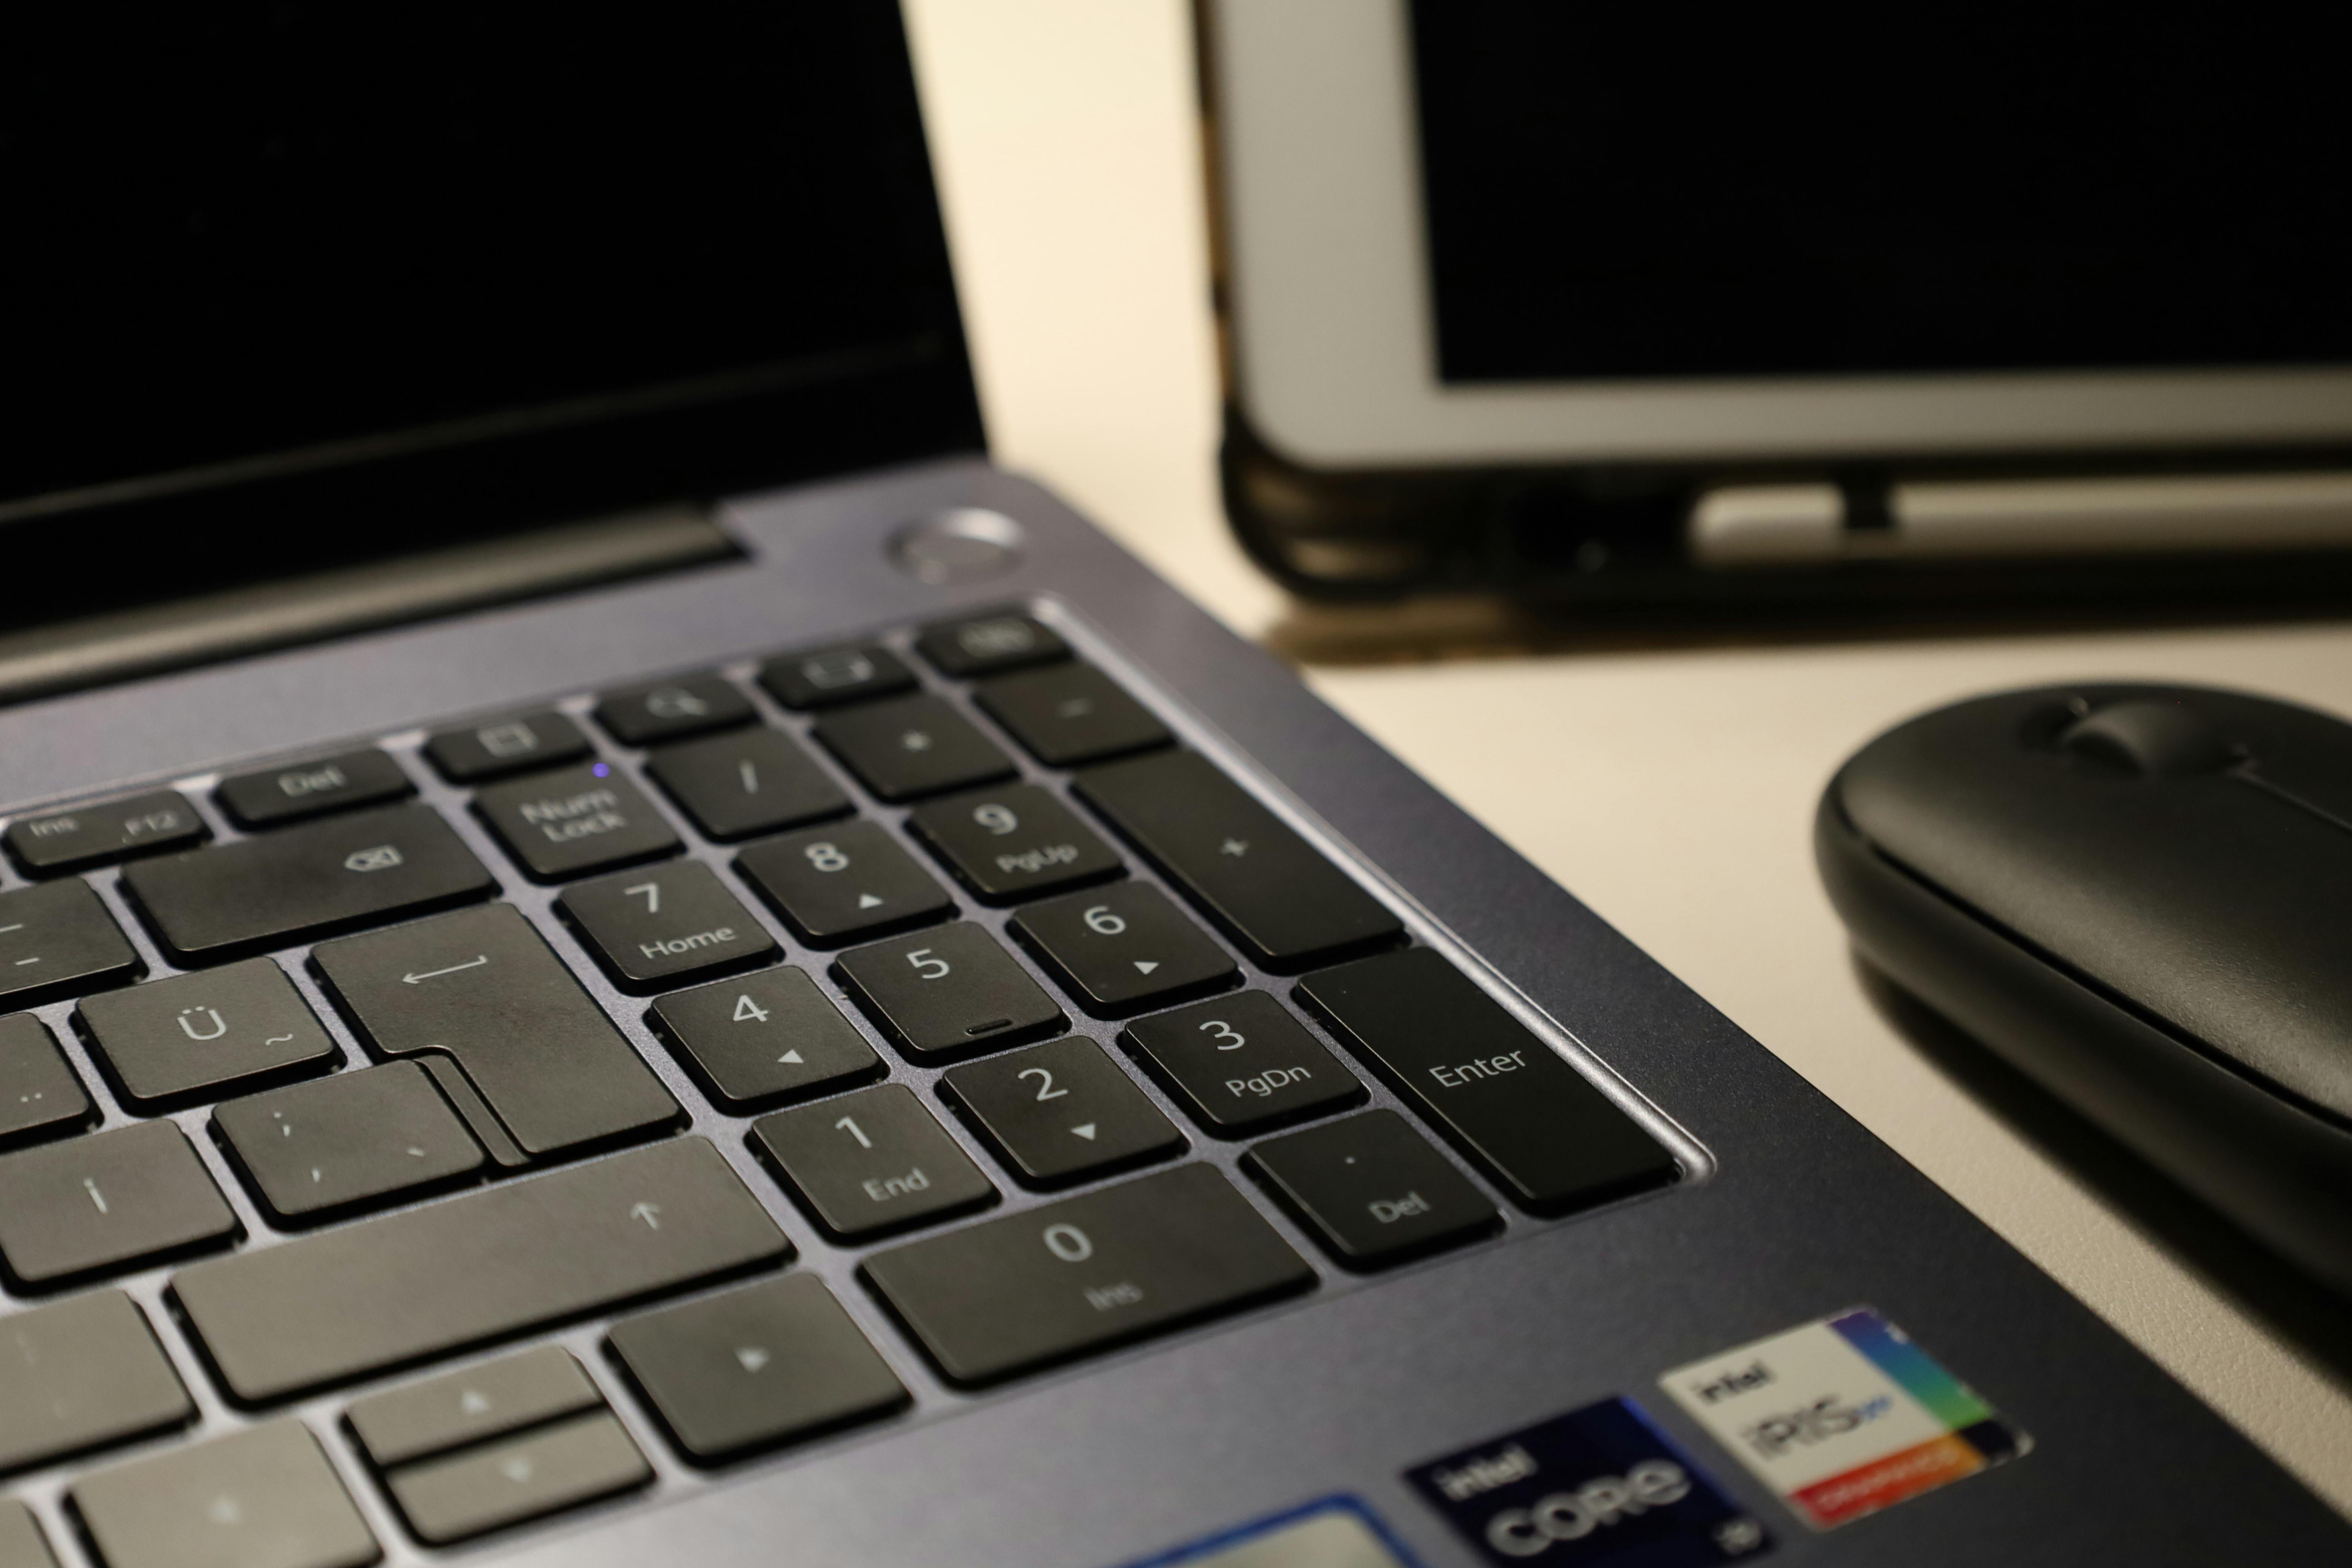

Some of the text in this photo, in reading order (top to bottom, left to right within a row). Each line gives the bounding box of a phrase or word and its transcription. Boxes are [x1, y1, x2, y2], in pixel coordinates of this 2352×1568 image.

[519, 789, 618, 825] Num
[972, 803, 1018, 835] 9
[541, 812, 625, 842] Lock
[804, 842, 850, 874] 8
[995, 844, 1079, 874] PgUp
[624, 882, 660, 913] 7
[1083, 905, 1126, 935] 6
[639, 926, 737, 959] Home
[906, 948, 950, 979] 5
[177, 1006, 227, 1040] Ü
[732, 994, 769, 1022] 4
[1199, 1020, 1245, 1051] 3
[1018, 1068, 1068, 1101] 2
[1225, 1065, 1312, 1098] PgDn
[1429, 1050, 1526, 1087] Enter
[835, 1116, 872, 1149] 1
[862, 1167, 930, 1202] End
[1368, 1191, 1430, 1223] Del
[1043, 1223, 1093, 1262] 0
